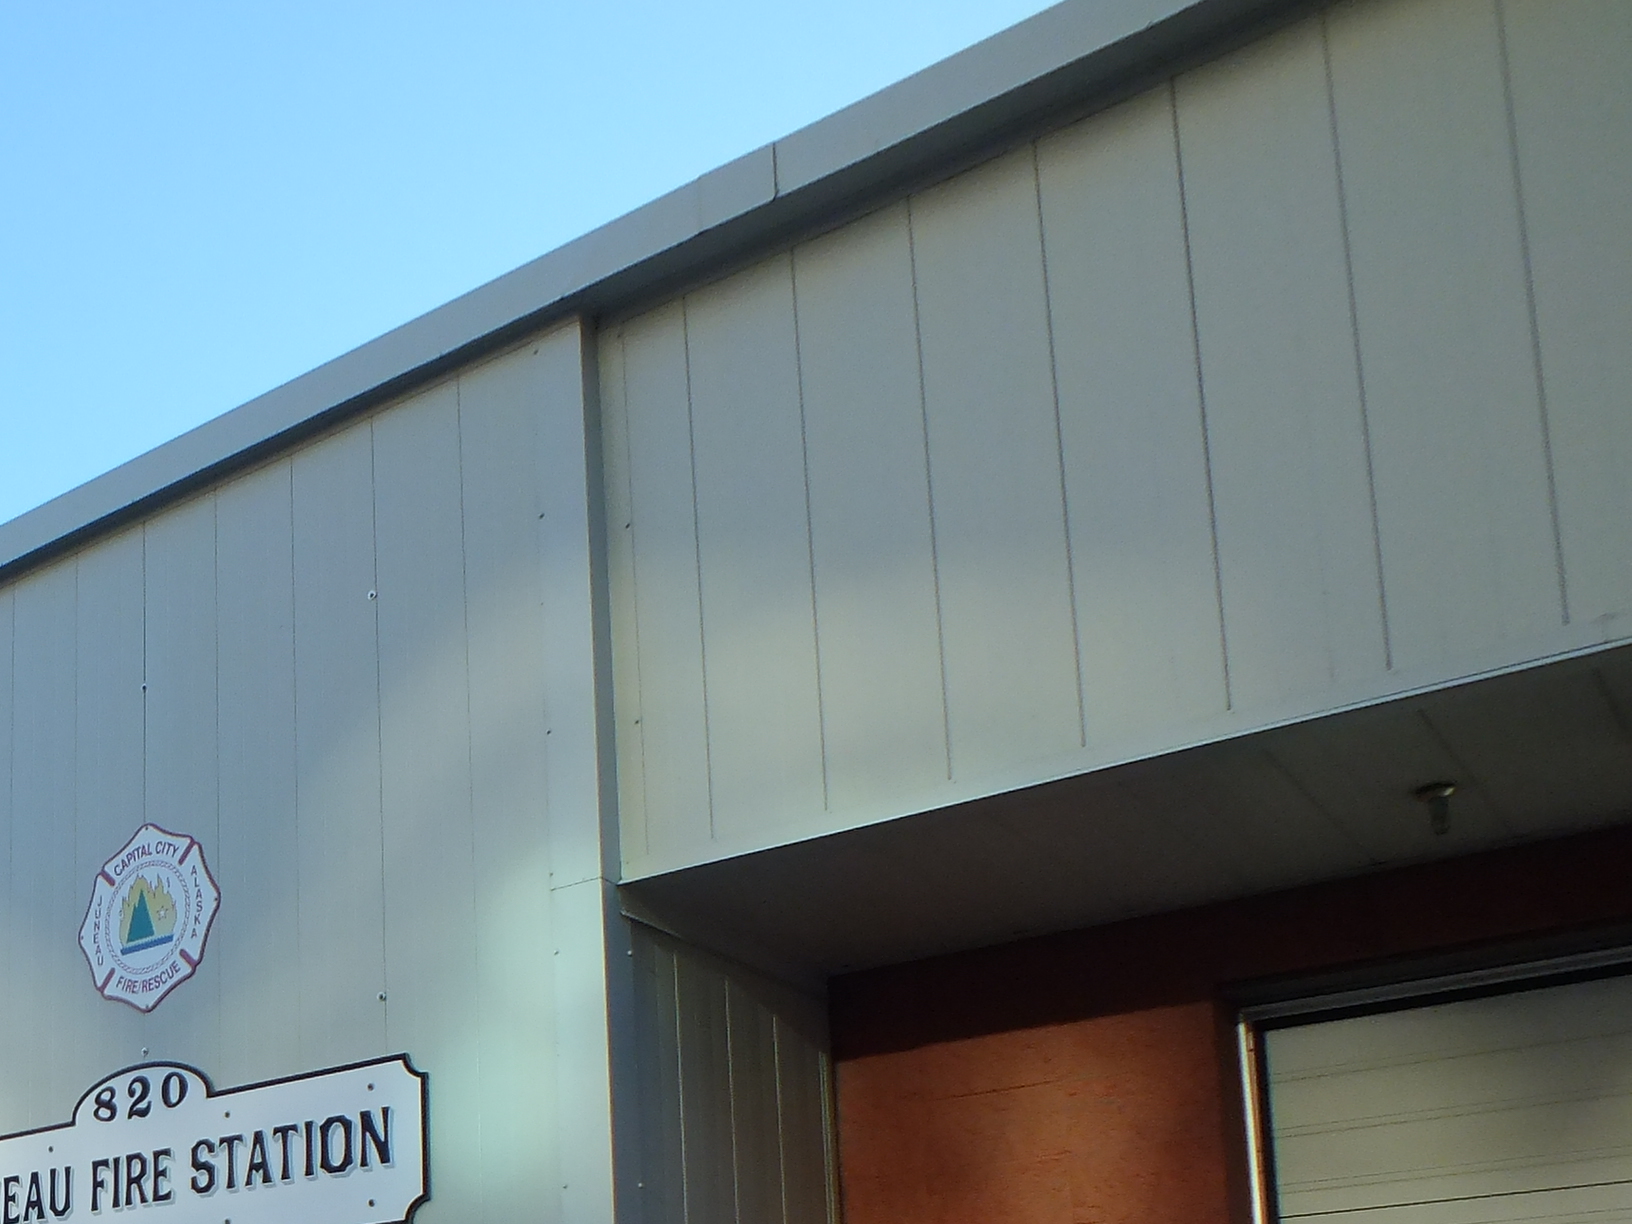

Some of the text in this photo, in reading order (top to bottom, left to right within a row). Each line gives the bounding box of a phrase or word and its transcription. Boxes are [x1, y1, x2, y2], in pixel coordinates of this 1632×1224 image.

[113, 840, 180, 876] CAPITAL CITY
[93, 895, 104, 966] JUNEAU
[190, 865, 203, 939] ALASKA
[115, 959, 181, 995] FIRE/RESCUE
[92, 1071, 190, 1123] 820
[90, 1148, 174, 1212] FIRE
[189, 1105, 392, 1195] STATION
